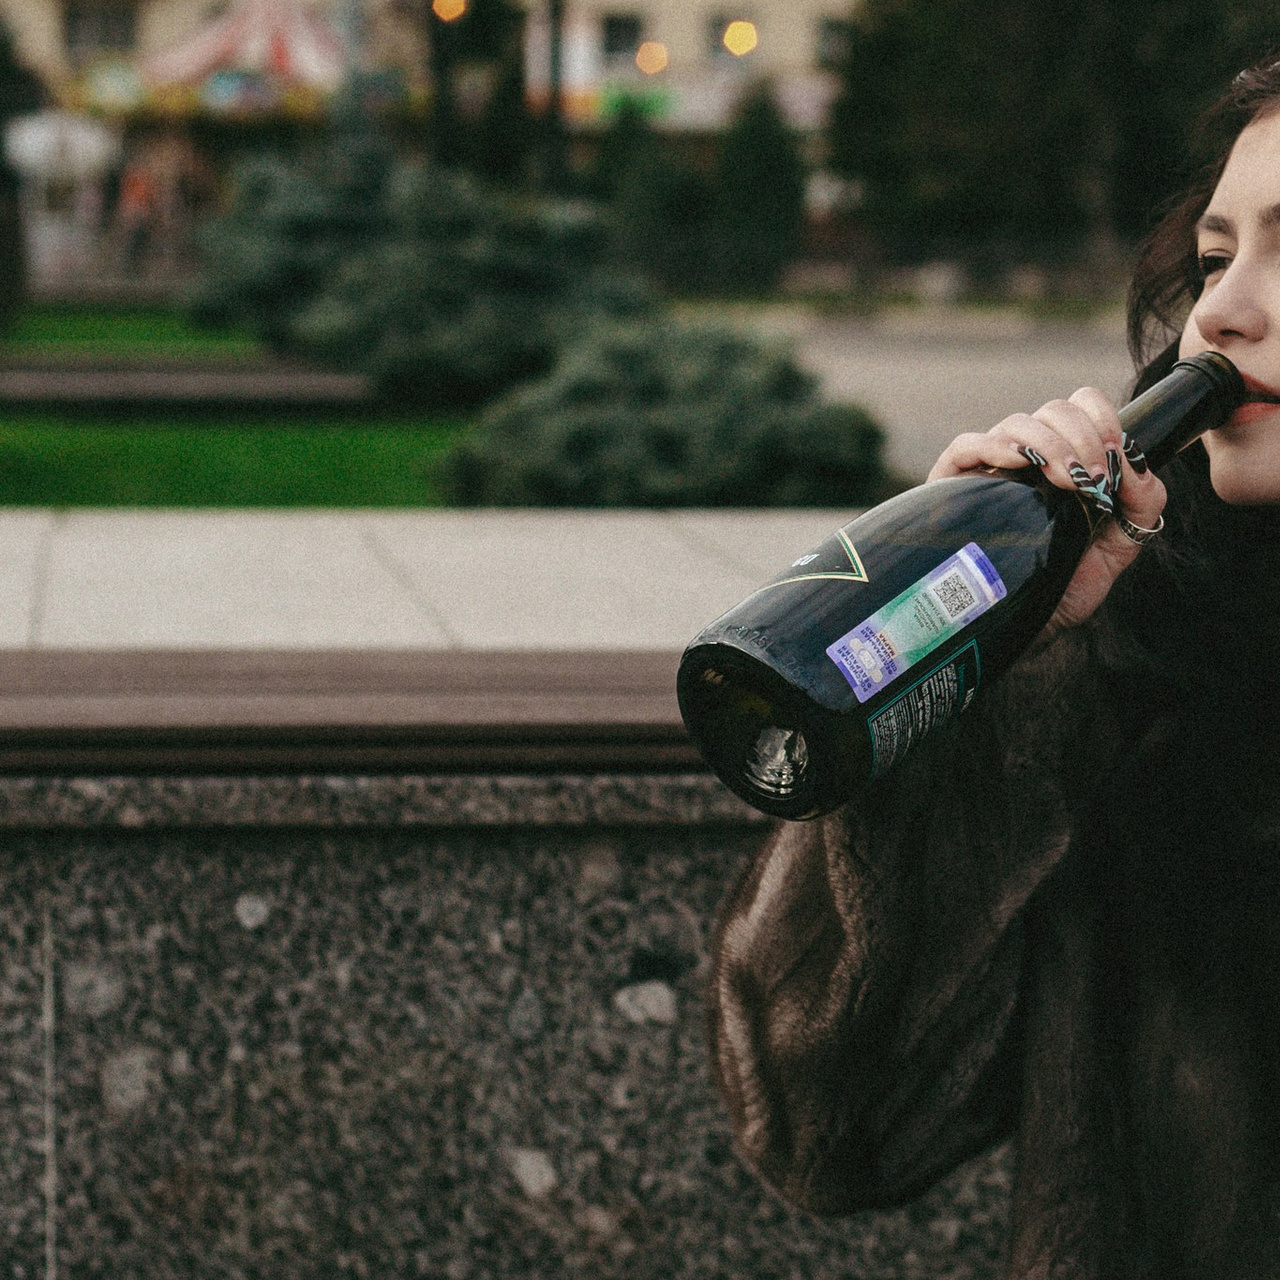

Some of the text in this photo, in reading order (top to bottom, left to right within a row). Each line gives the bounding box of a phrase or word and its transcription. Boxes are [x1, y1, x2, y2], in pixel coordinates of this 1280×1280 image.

[860, 628, 893, 675] ФЕДЕРАЛЬНАЯ
[865, 626, 898, 672] СПЕЦИАЛЬНАЯ
[879, 633, 895, 657] МАРКА
[837, 648, 868, 692] РОССИЙСКАЯ
